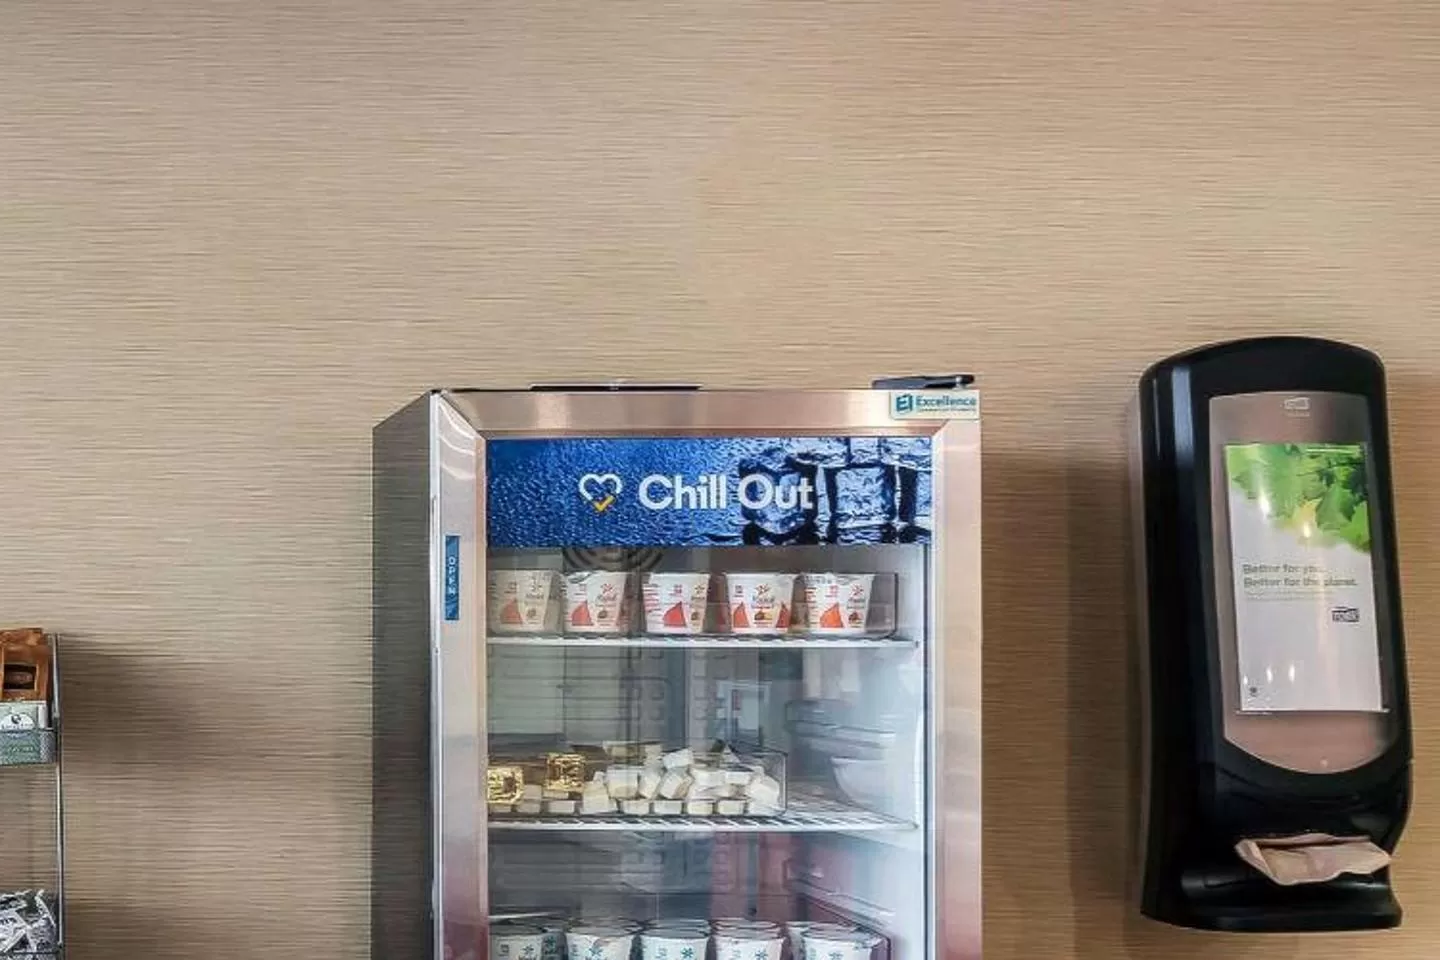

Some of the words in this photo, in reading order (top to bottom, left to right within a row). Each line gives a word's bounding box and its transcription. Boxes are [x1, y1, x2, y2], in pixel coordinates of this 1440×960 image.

[916, 395, 977, 406] Excellence
[638, 473, 728, 510] Chill
[737, 473, 814, 510] Out
